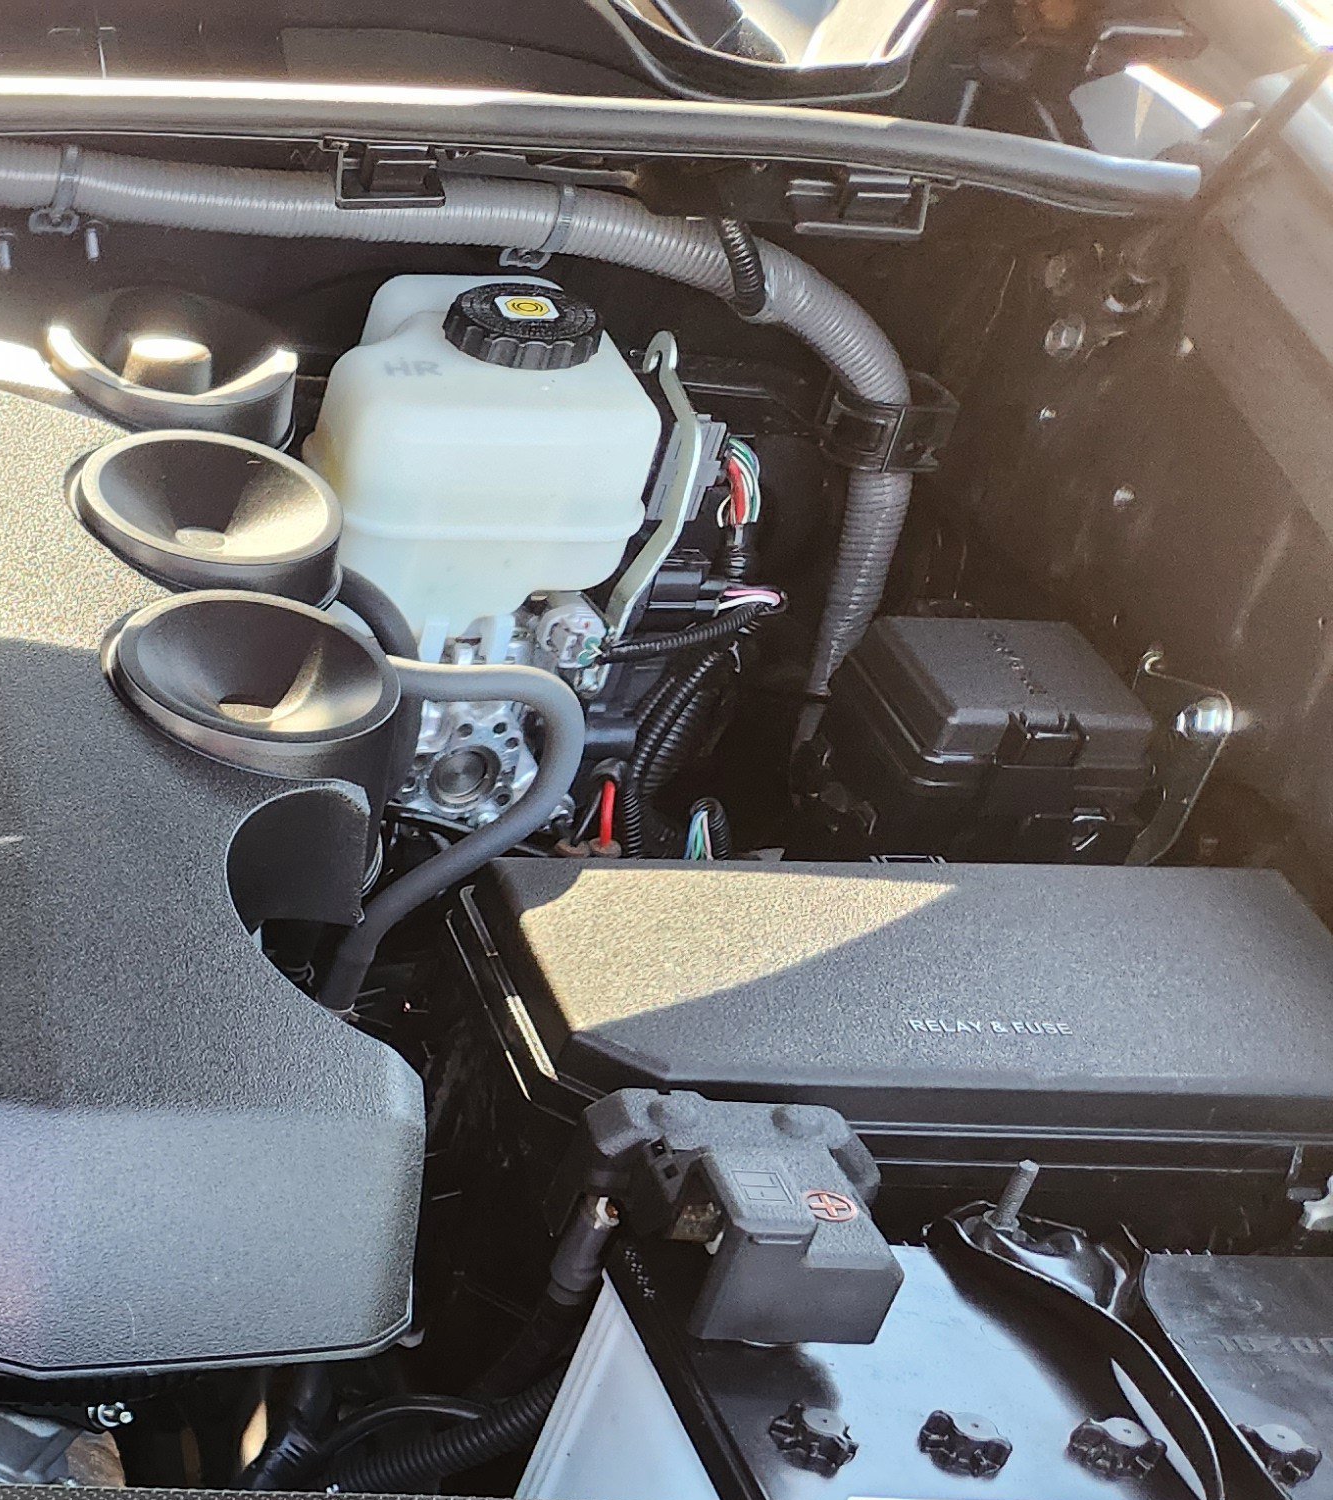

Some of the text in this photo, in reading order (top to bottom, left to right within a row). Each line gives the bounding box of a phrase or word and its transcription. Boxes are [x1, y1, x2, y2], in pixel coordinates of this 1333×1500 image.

[908, 1018, 1073, 1036] RELAY & FUSE
